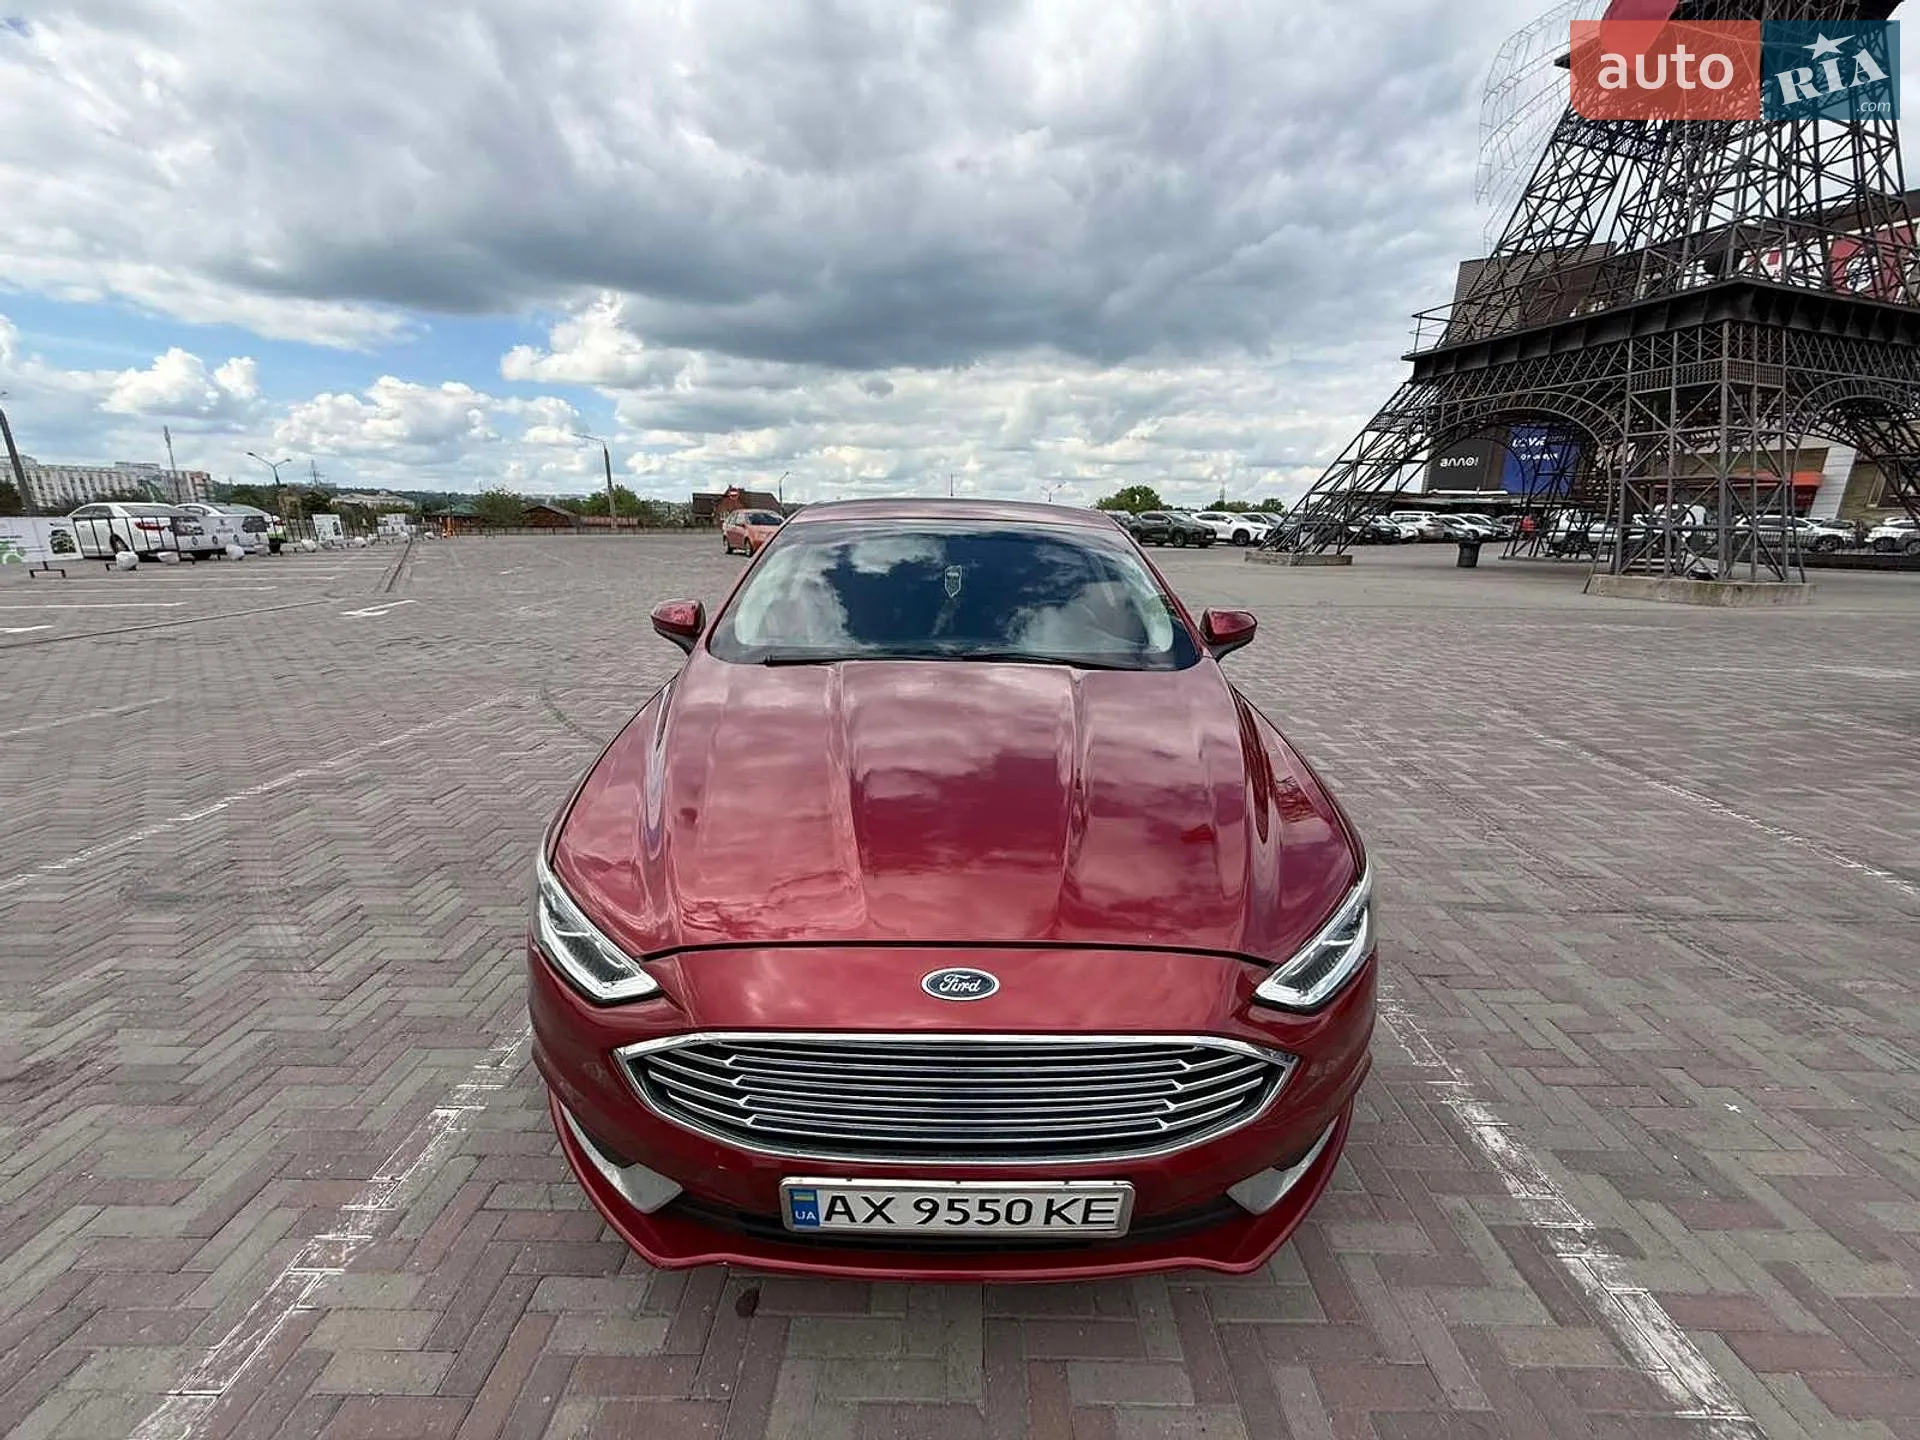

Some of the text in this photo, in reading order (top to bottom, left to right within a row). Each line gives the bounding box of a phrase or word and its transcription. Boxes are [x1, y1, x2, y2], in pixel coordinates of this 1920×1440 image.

[939, 974, 981, 992] Ford
[794, 1209, 816, 1221] UA
[822, 1195, 1119, 1226] AX 9550 KE
